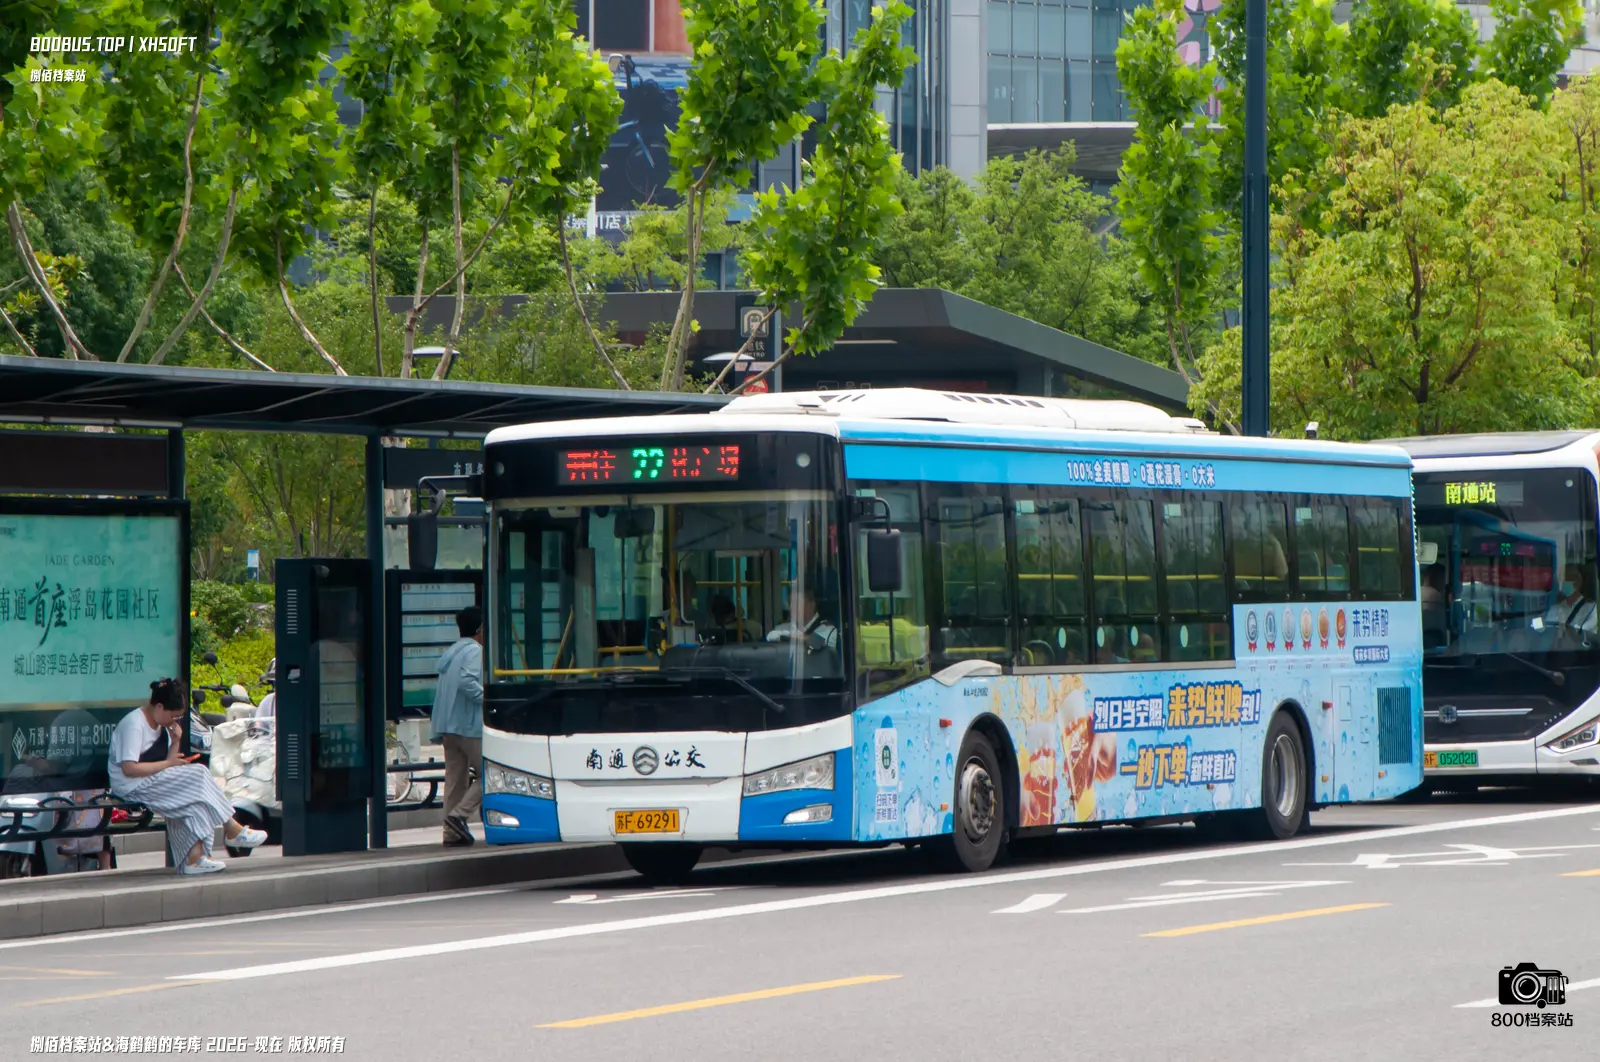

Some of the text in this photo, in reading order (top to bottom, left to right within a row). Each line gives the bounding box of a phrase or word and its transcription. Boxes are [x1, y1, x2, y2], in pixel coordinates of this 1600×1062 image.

[1445, 482, 1496, 504] 南通站
[45, 554, 115, 566] JADE GARDEN
[0, 575, 160, 648] 南通首座浮岛花园社区
[14, 652, 145, 676] 城山路浮岛会客厅 盛大开放
[586, 745, 706, 770] 南通 公交
